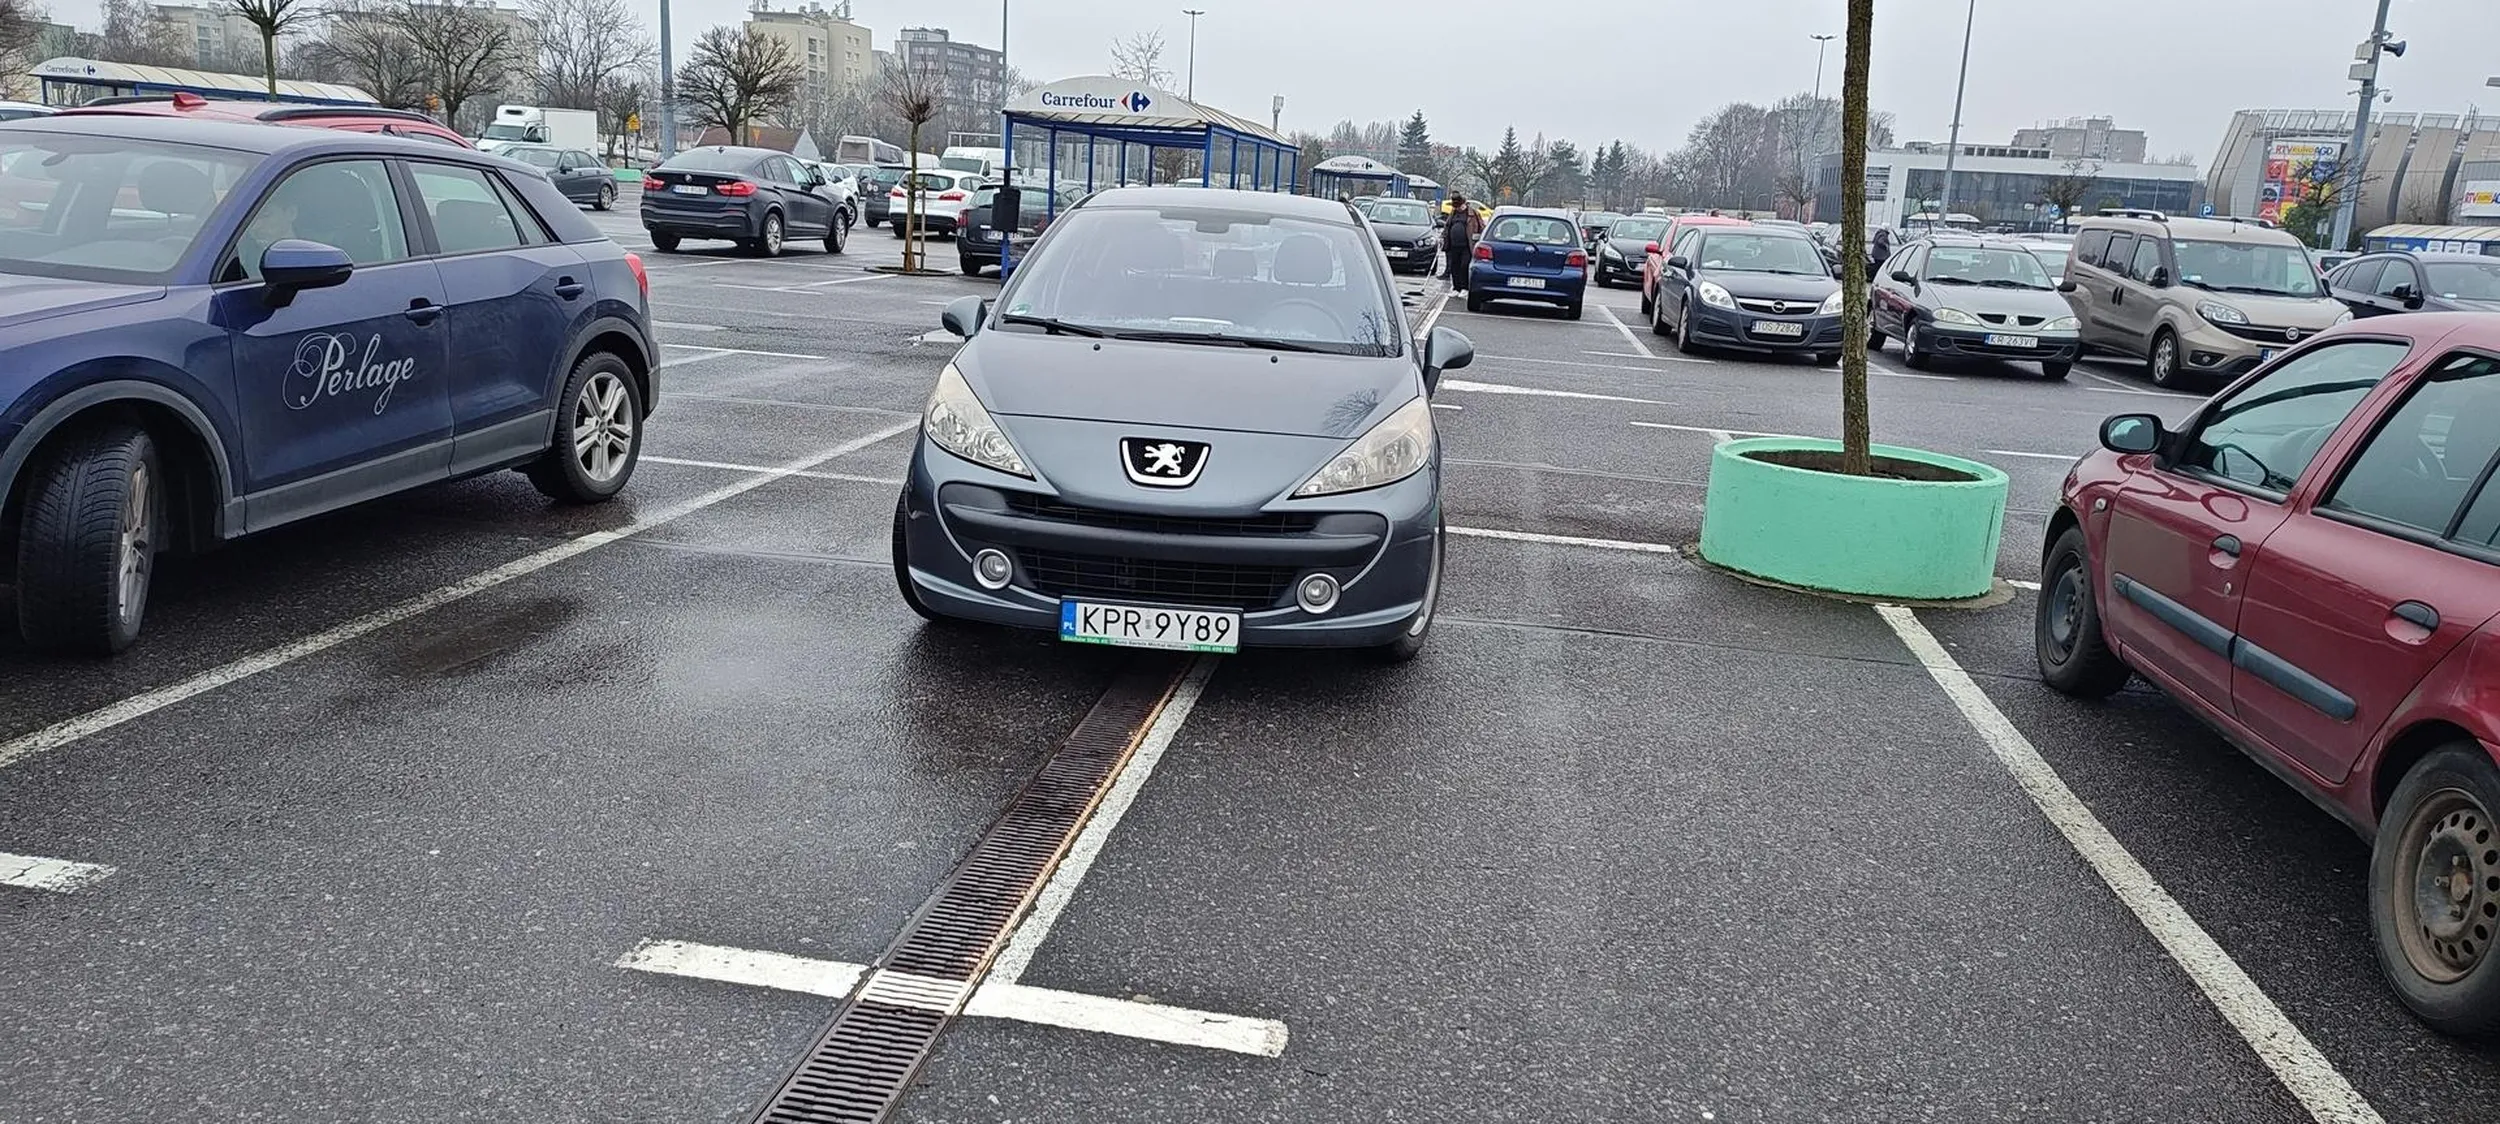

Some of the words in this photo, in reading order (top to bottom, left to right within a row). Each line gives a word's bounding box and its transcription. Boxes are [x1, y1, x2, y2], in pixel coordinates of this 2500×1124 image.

[1042, 91, 1116, 109] Carrefour
[2275, 144, 2292, 155] RTV
[283, 332, 415, 415] Perlage
[1083, 606, 1142, 638] KPR
[1155, 612, 1231, 643] 9Y89
